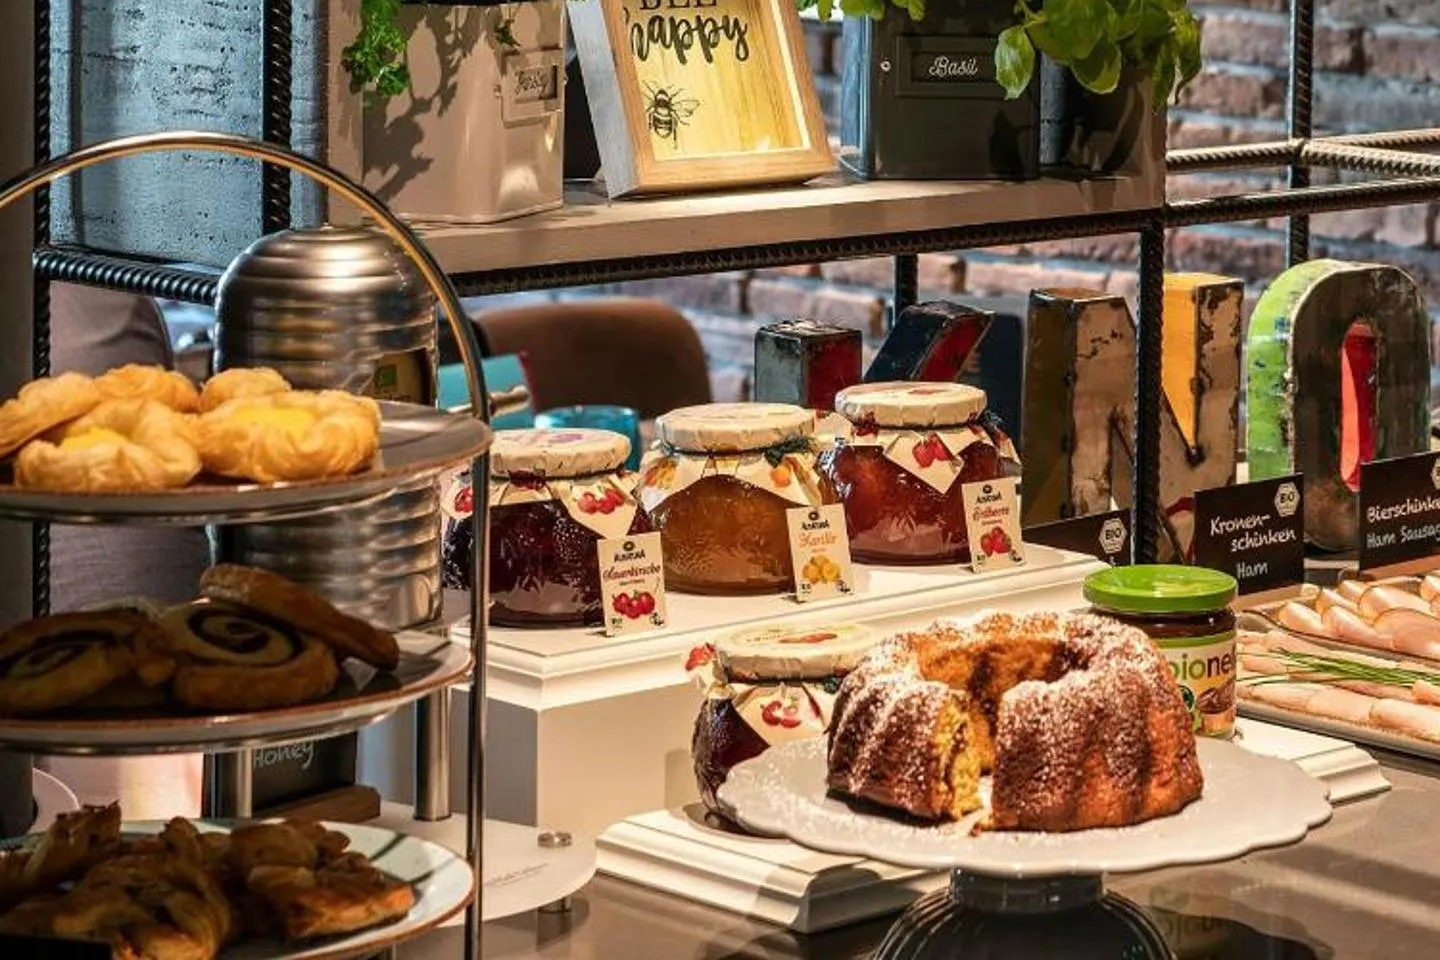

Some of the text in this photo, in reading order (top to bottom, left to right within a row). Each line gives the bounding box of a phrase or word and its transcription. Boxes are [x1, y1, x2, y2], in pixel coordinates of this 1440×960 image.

[928, 54, 979, 78] Basil
[1104, 527, 1122, 541] BIO
[1210, 513, 1272, 537] Kronen-
[1230, 528, 1298, 553] schinken
[1366, 531, 1397, 550] Ham
[1235, 561, 1269, 580] Ham
[252, 739, 314, 770] Honey
